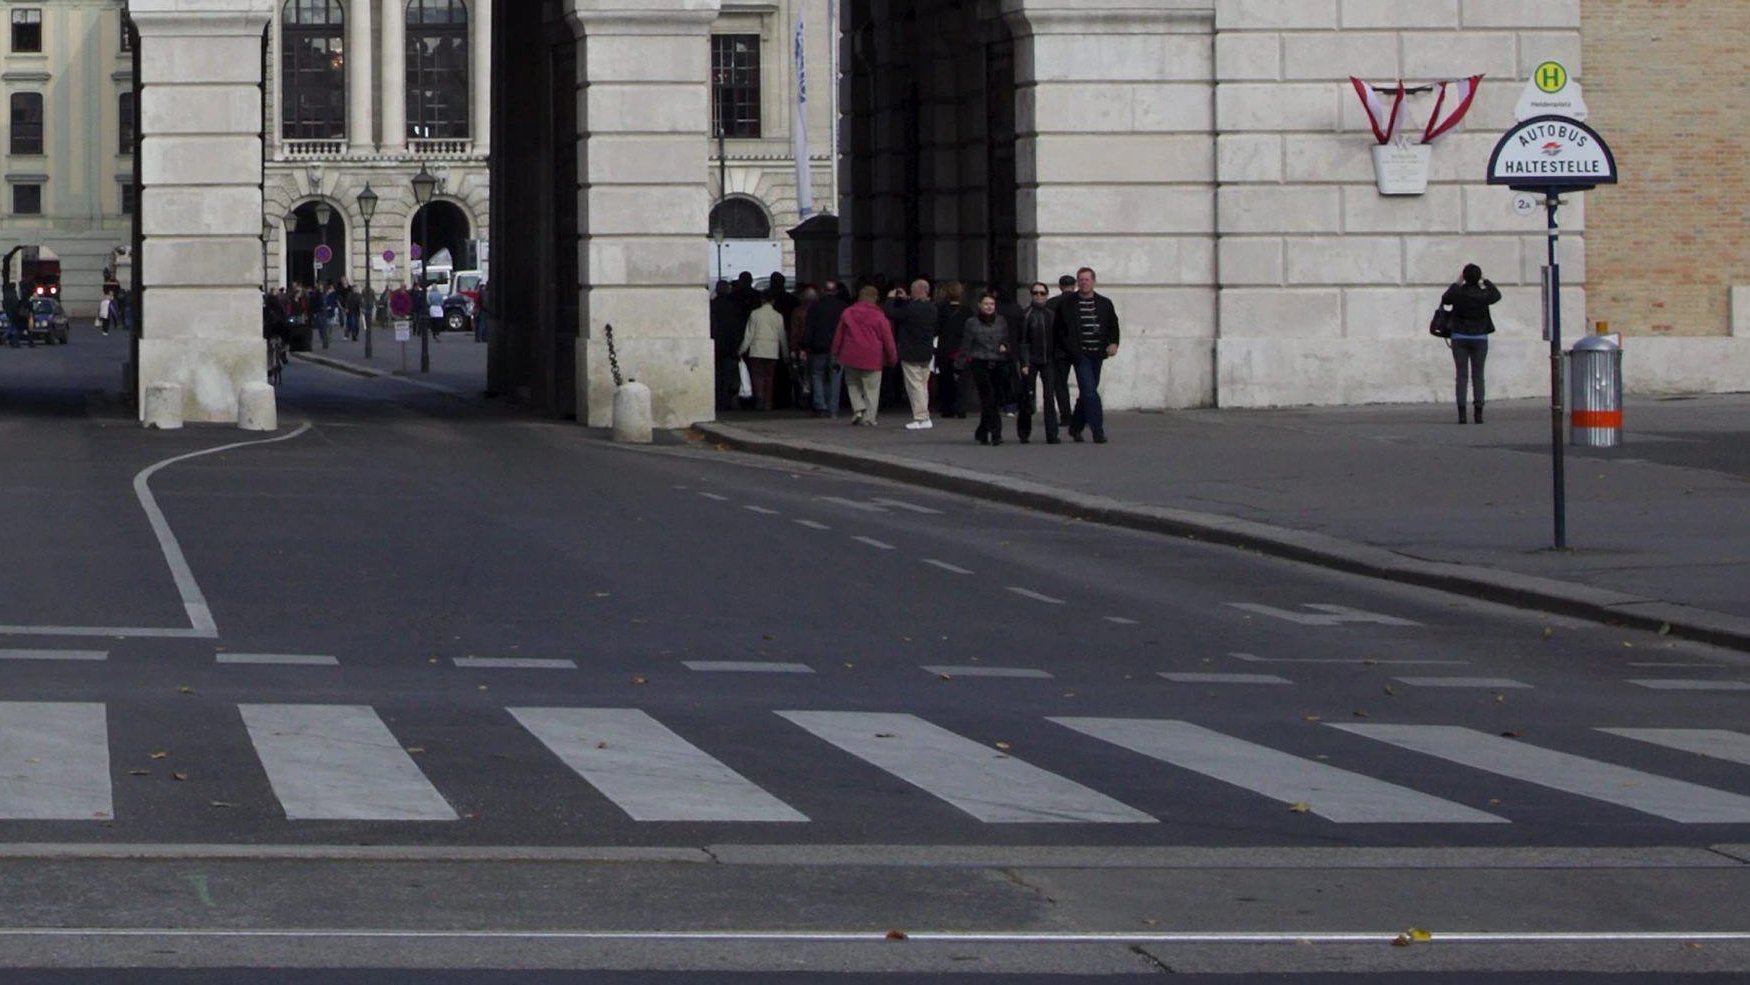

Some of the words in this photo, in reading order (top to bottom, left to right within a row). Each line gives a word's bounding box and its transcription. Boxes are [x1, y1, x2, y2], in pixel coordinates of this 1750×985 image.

[1542, 67, 1559, 88] H
[1518, 124, 1588, 148] AUTOBUS
[1505, 160, 1600, 173] HALTESTELLE
